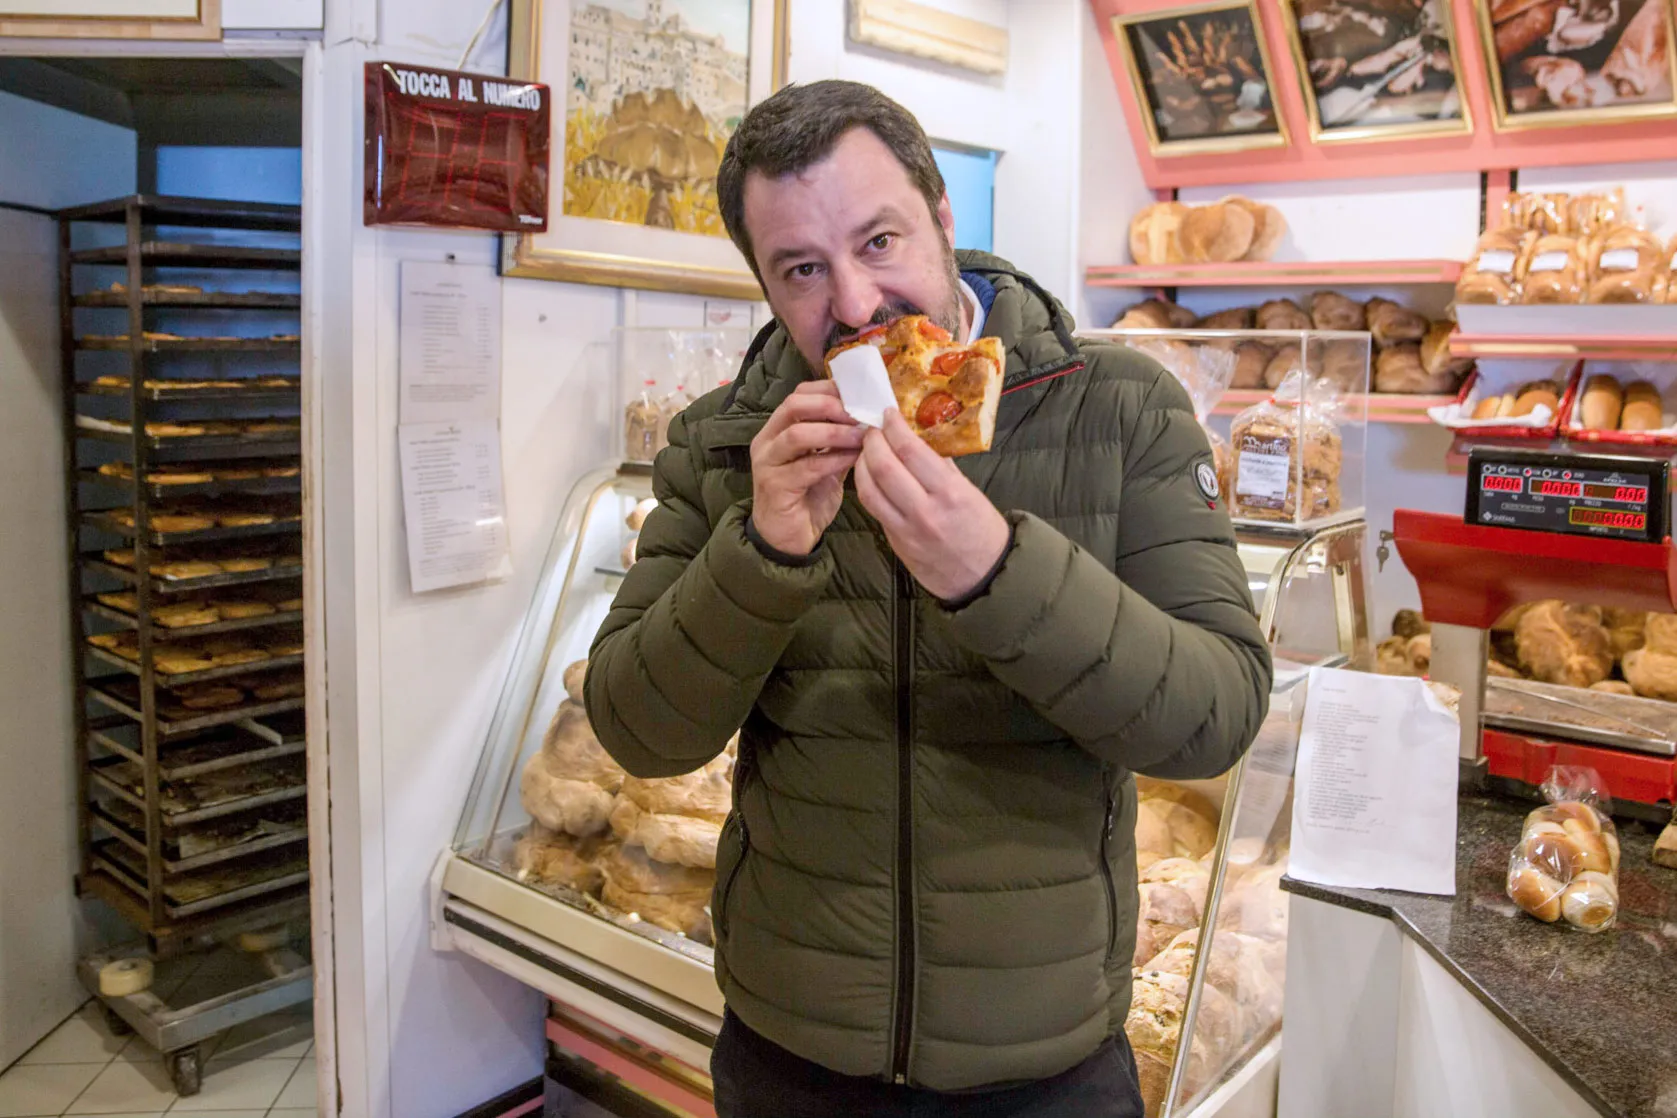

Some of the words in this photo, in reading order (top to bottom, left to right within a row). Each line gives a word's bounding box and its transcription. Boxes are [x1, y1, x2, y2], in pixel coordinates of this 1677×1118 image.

[397, 69, 451, 100] TOCCA
[458, 78, 478, 102] AL
[482, 81, 541, 111] NUMERO
